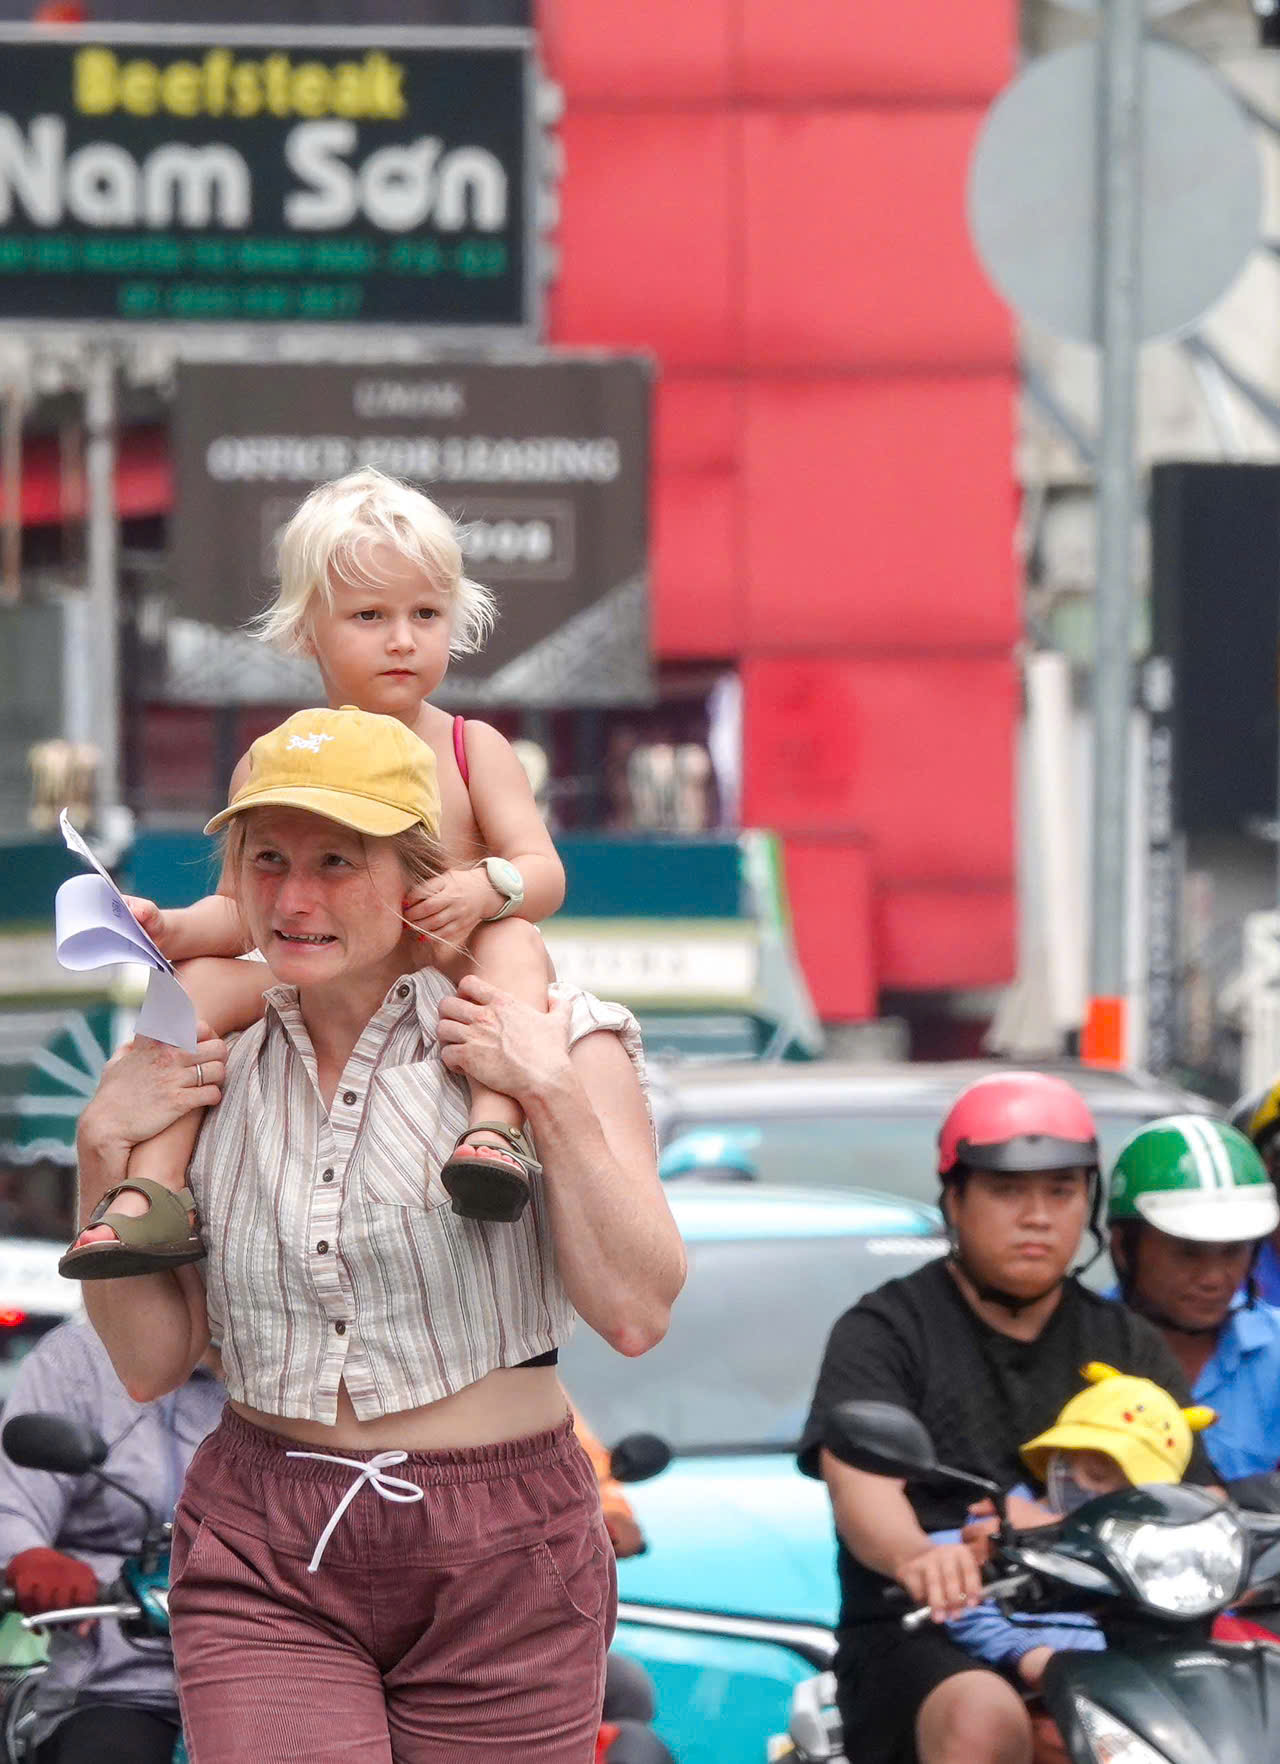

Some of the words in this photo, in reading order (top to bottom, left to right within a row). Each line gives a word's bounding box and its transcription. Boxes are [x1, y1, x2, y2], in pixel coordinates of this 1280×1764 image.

[75, 47, 404, 118] Beefsteak
[208, 437, 351, 479] OFFICE
[446, 438, 618, 482] LEASING
